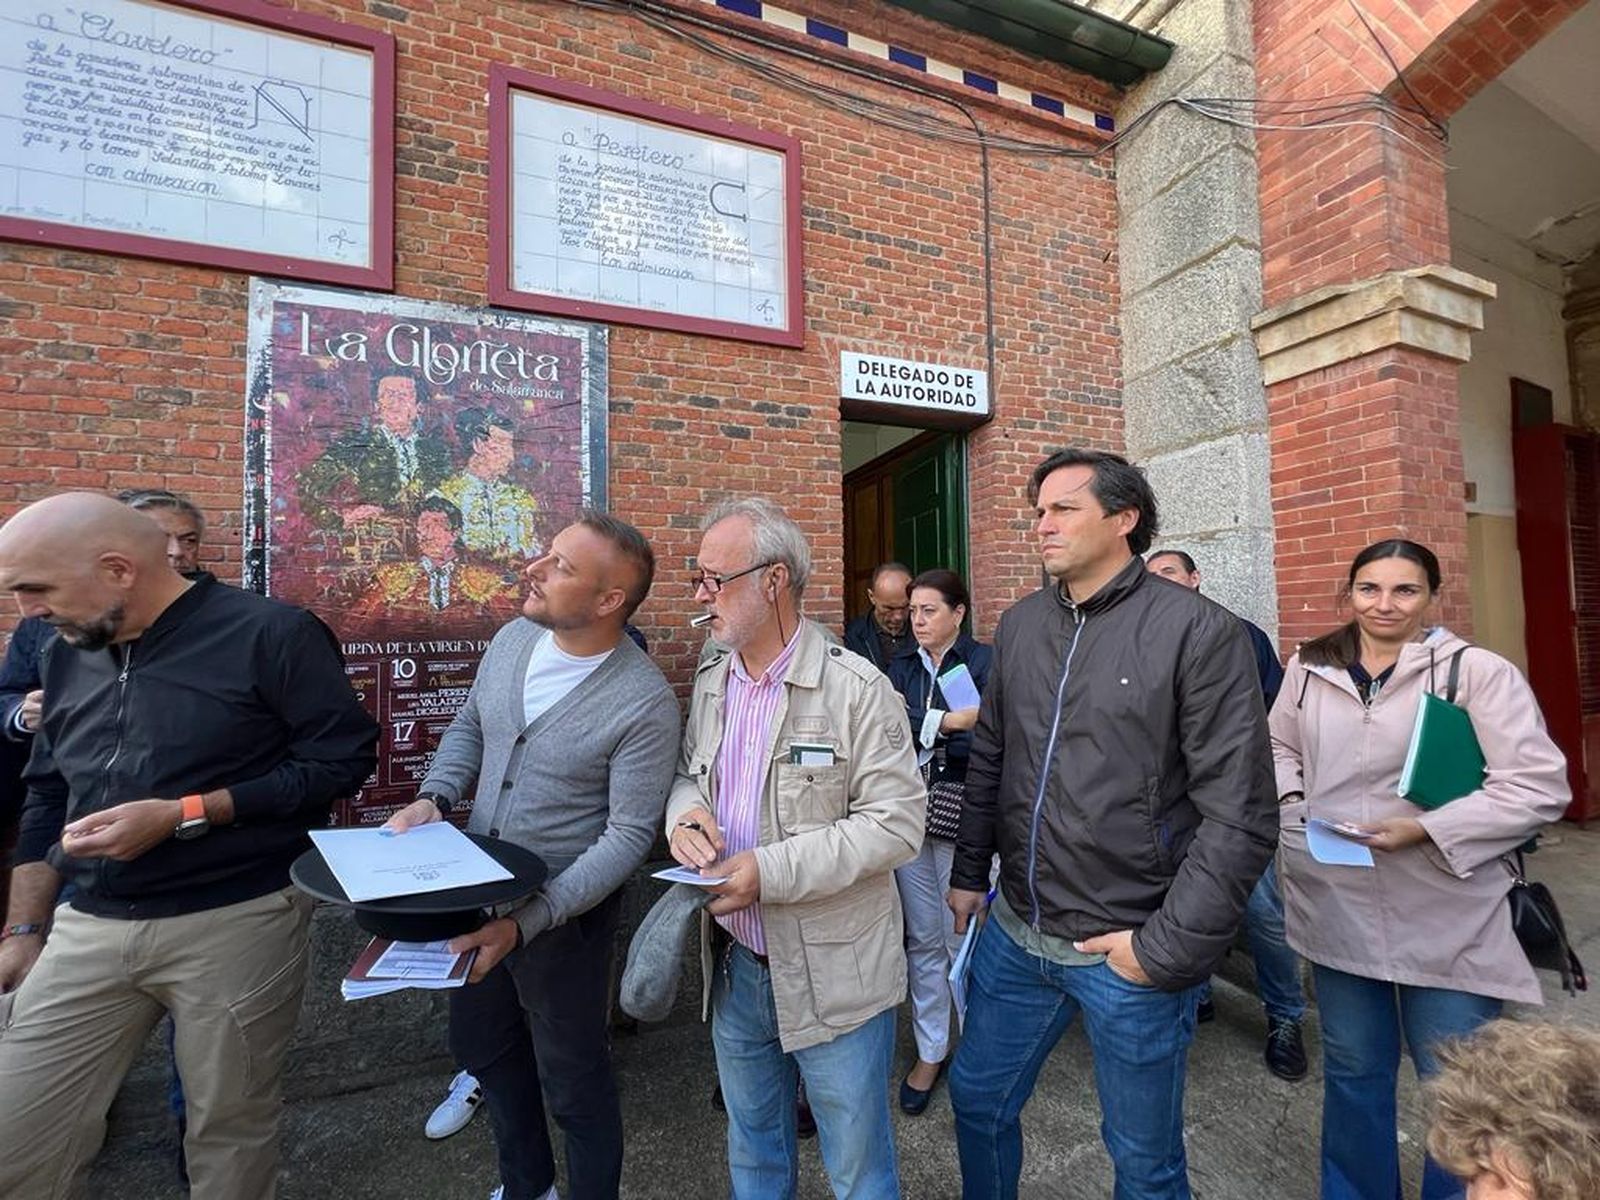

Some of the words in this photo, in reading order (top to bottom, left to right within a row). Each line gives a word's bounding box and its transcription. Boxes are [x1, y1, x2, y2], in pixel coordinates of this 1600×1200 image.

[85, 162, 115, 178] con
[300, 311, 367, 362] La
[386, 323, 560, 385] Glorieta
[858, 360, 949, 385] DELEGADO
[954, 374, 973, 389] DE
[856, 379, 876, 395] LA
[880, 383, 976, 407] AUTORIDAD
[391, 658, 416, 679] 10
[393, 721, 416, 742] 17
